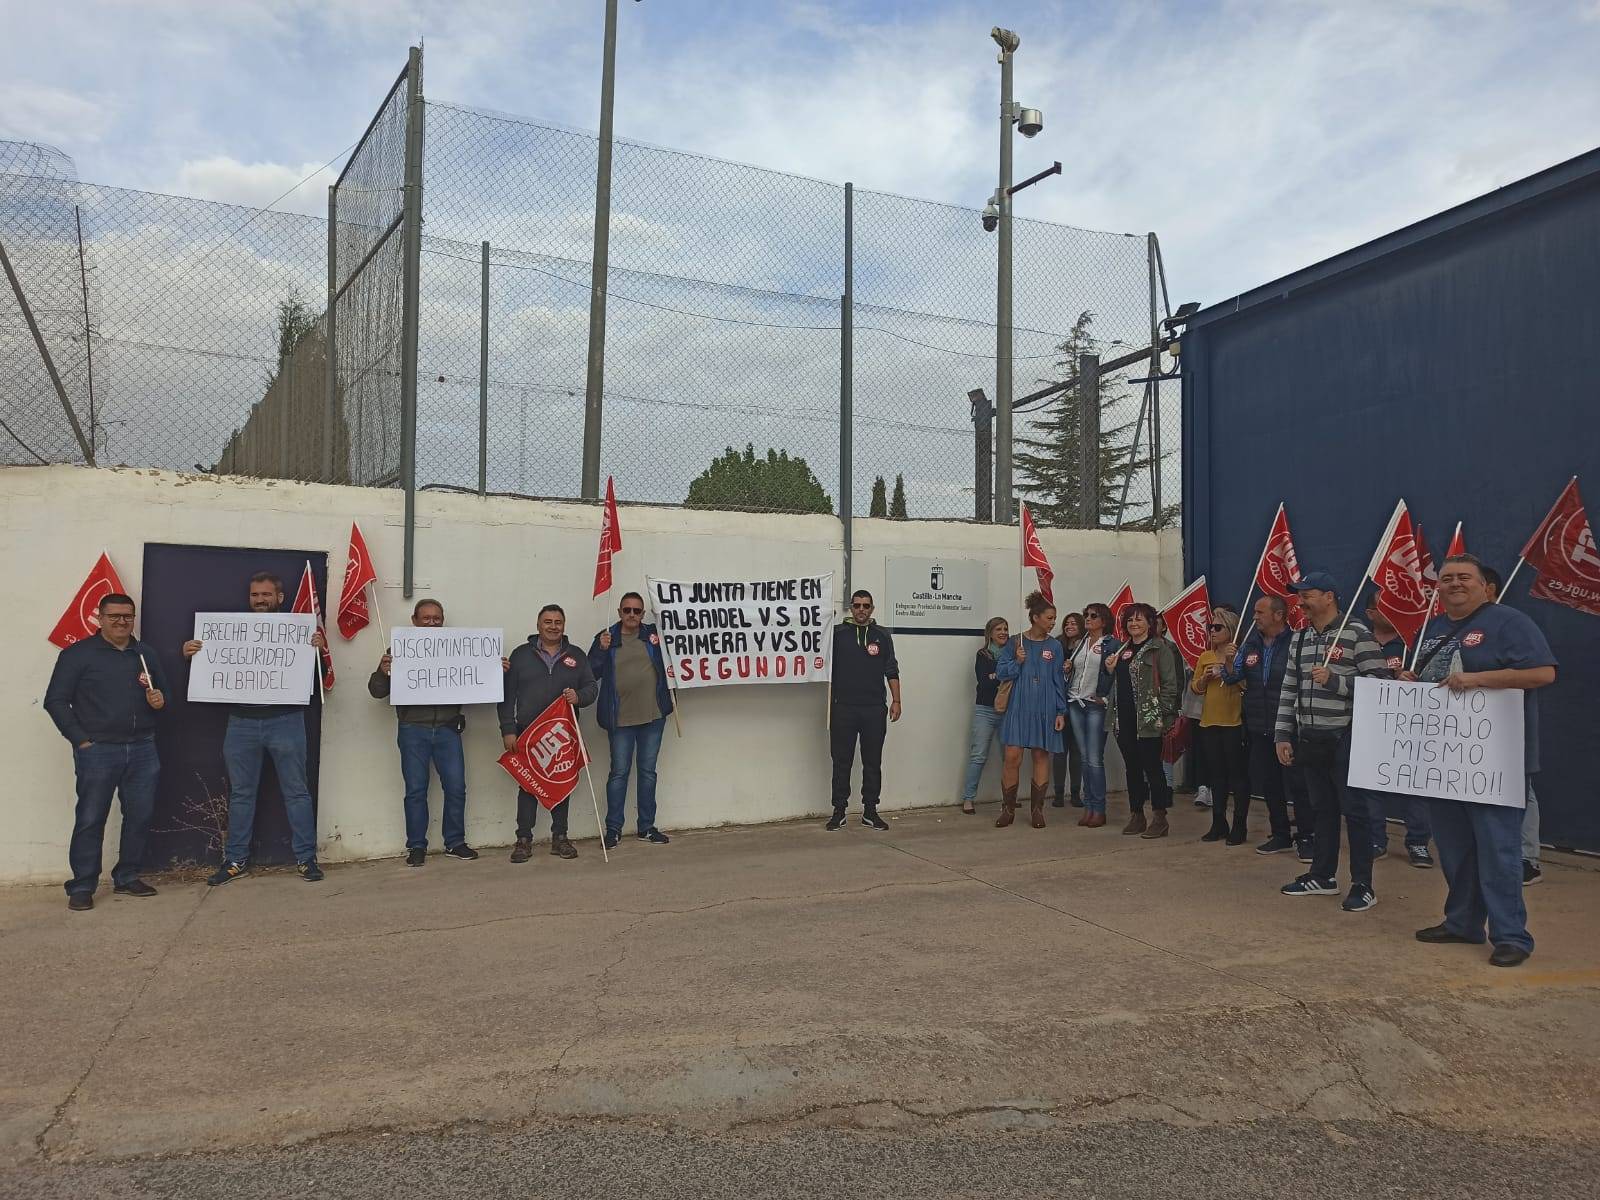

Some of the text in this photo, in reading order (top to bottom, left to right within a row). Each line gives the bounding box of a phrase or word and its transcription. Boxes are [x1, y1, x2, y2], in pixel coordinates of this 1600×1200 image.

[657, 579, 822, 603] LA JUNTA TIENE EN
[661, 607, 752, 630] ALBAIDEL
[799, 605, 822, 627] DE
[202, 622, 313, 646] BRECHA SALARIAL
[664, 632, 748, 655] PRIMERA
[753, 631, 766, 652] Y
[801, 630, 822, 653] DE
[407, 665, 485, 689] SALARIAL
[680, 655, 806, 681] SEGUNDA
[212, 671, 289, 691] ALBAIDEL
[1378, 712, 1492, 739] TRABAJO
[530, 722, 572, 769] UGT
[1393, 739, 1484, 765] MISMO
[1377, 762, 1503, 796] SALARIO!!
